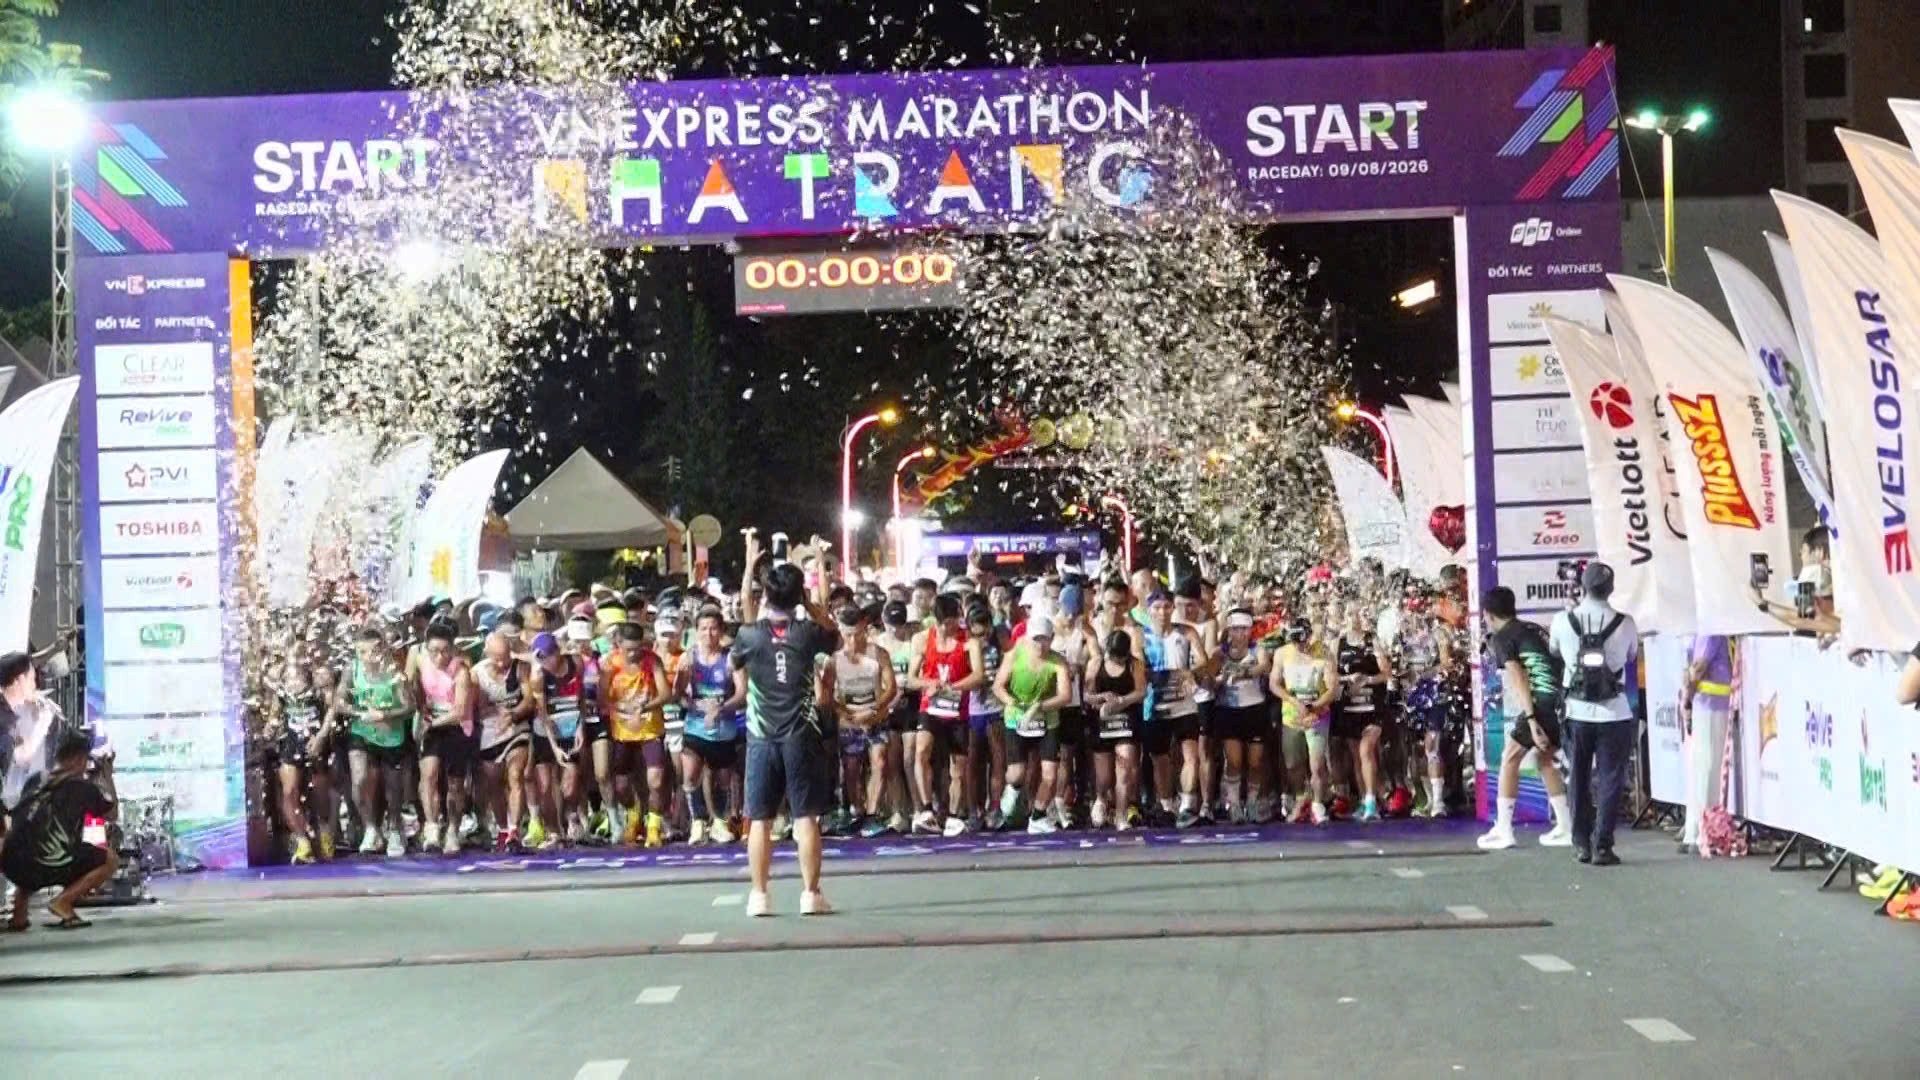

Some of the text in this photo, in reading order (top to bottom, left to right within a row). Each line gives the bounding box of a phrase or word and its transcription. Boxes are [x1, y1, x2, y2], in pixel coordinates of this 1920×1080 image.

[848, 89, 1149, 142] MARATHON
[1246, 100, 1428, 157] START
[252, 140, 438, 193] START
[1248, 159, 1429, 180] RACEDAY: 09/08/2026
[784, 141, 1154, 221] TRANG
[1510, 218, 1553, 246] FPT
[744, 254, 953, 290] 00:00:00
[1488, 262, 1603, 278] ĐỐI TÁC PARTNERS
[105, 275, 206, 295] VNEXPRESS
[95, 315, 117, 331] ĐỐI
[119, 315, 141, 329] TÁC
[150, 466, 188, 481] PVI
[1613, 436, 1653, 567] Vietlott
[115, 520, 203, 537] TOSHIBA
